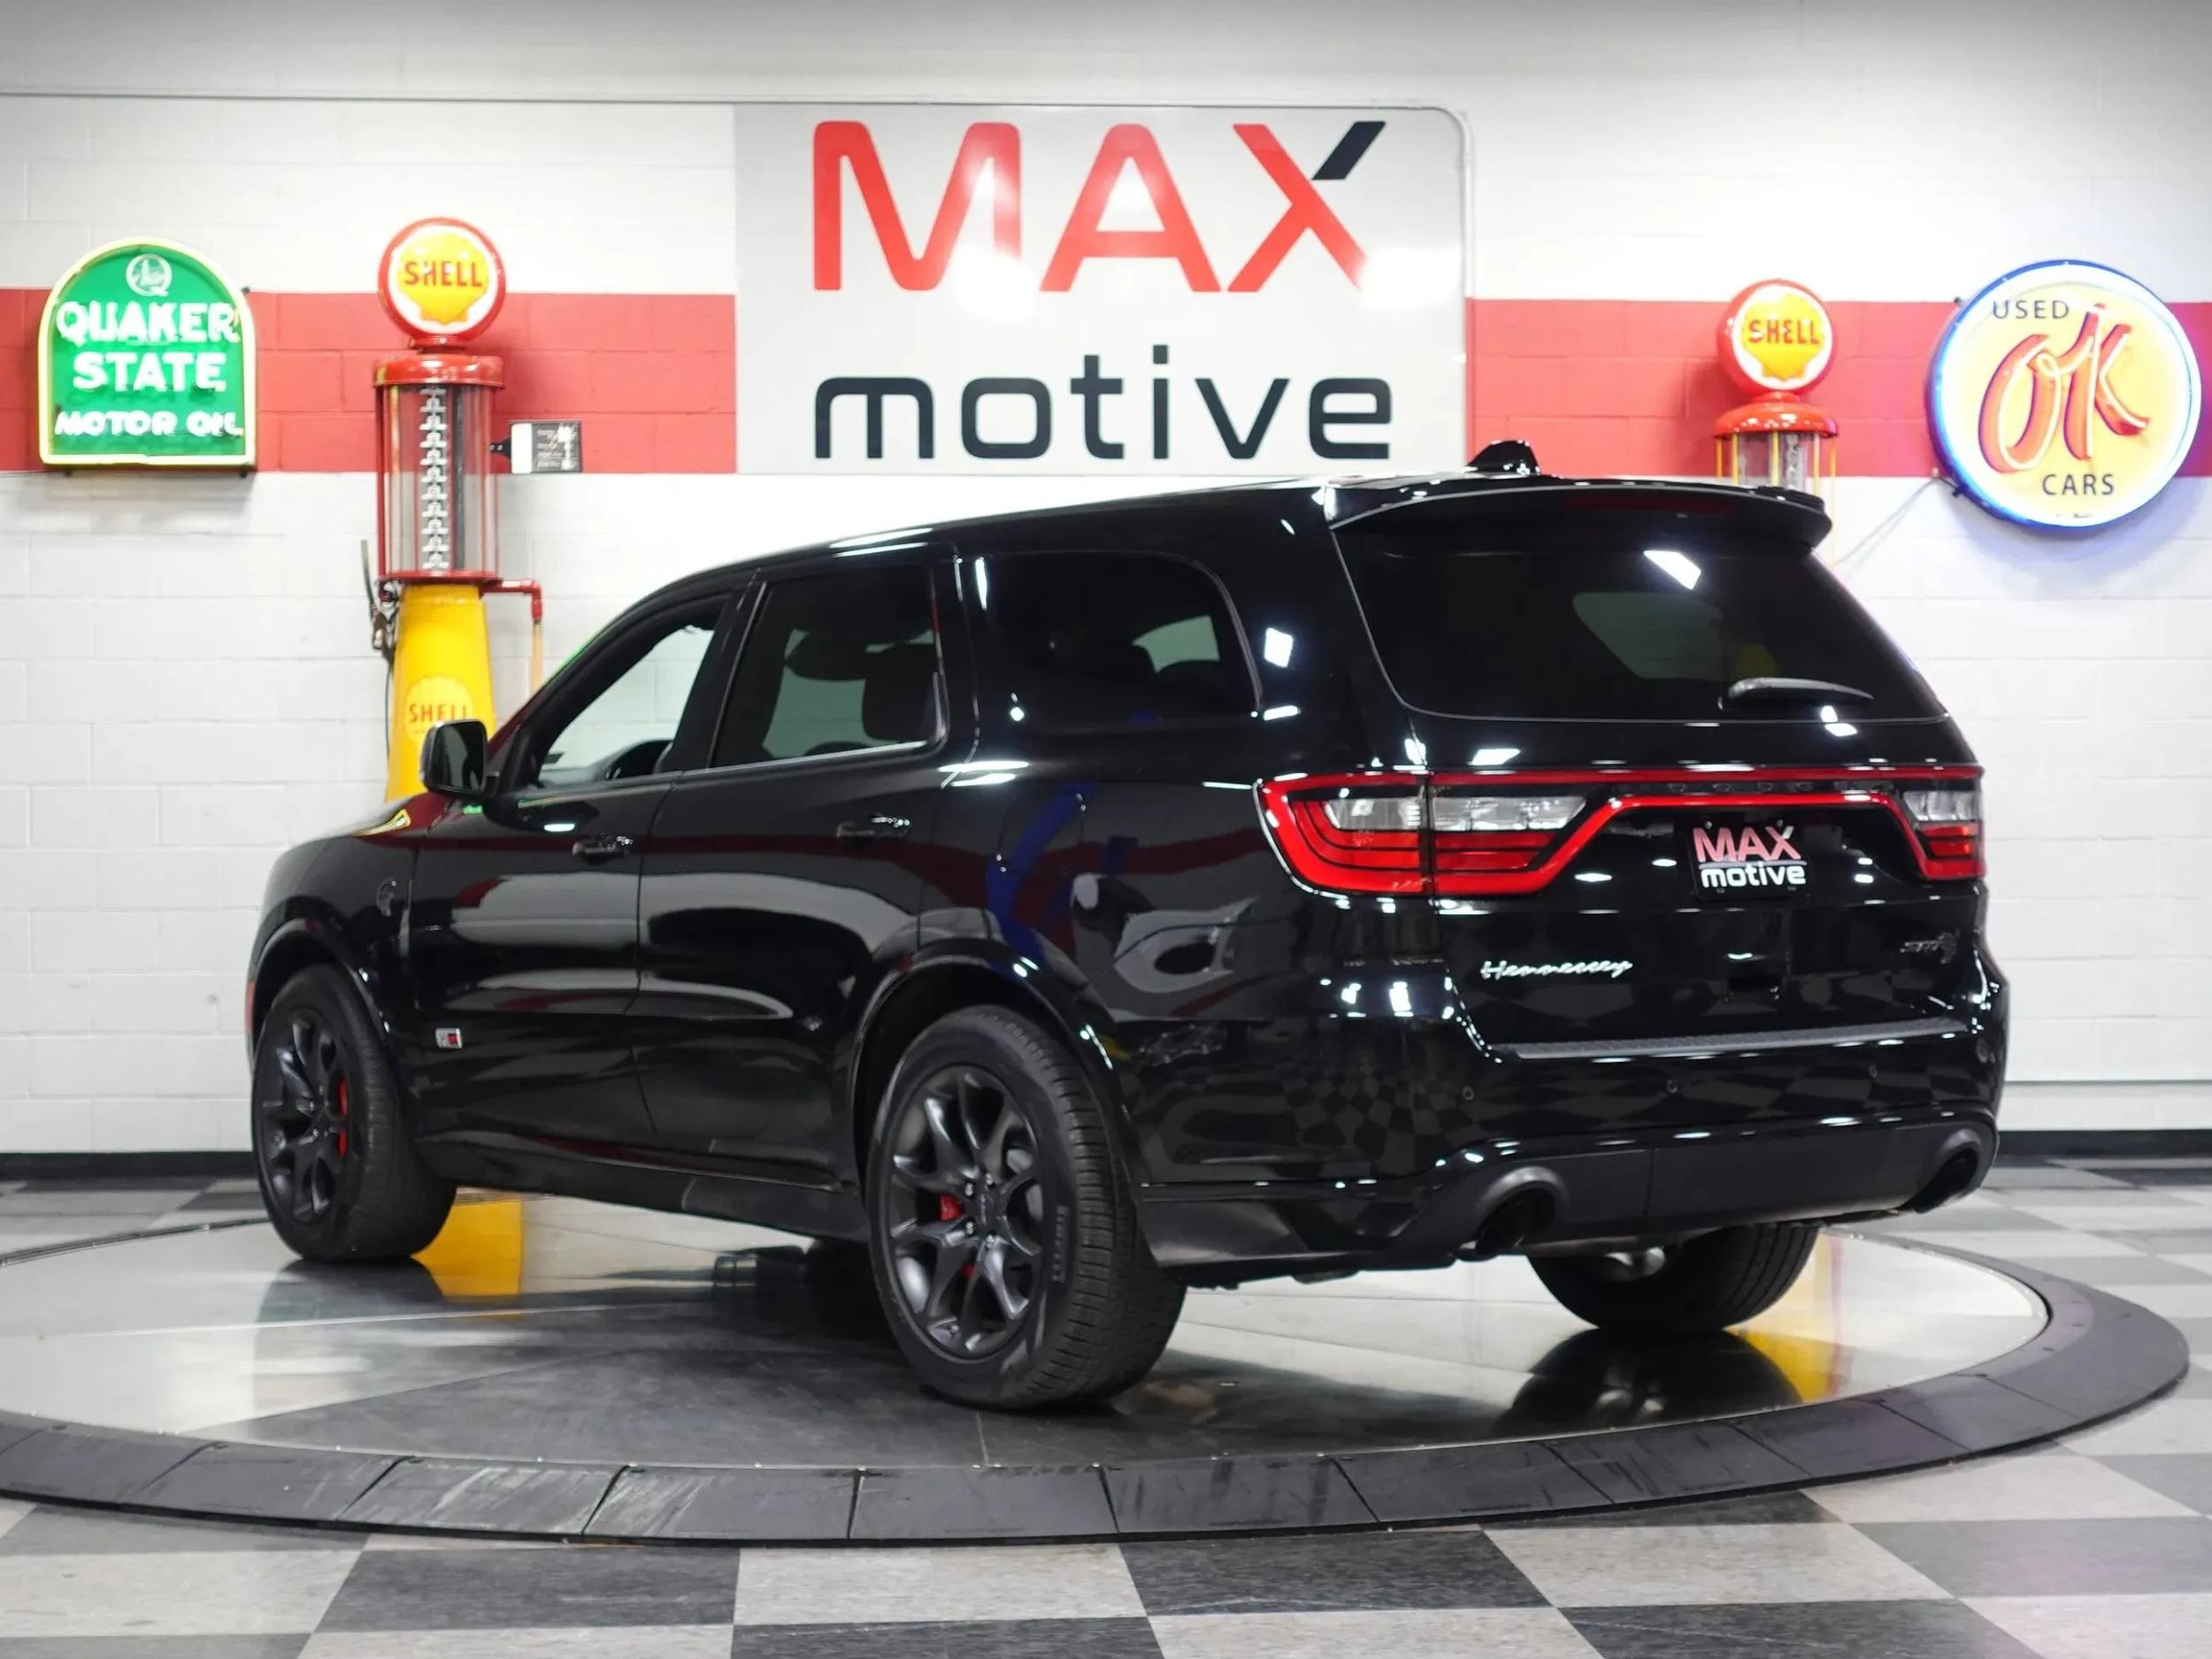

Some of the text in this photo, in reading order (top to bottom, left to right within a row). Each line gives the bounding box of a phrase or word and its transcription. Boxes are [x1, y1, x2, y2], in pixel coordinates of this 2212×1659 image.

[813, 120, 1386, 293] MAX
[403, 260, 482, 287] SHELL
[56, 300, 241, 347] QUAKER
[1993, 300, 2070, 319] USED
[1748, 319, 1819, 344] SHELL
[73, 351, 227, 392] STATE
[814, 345, 1392, 459] motive
[1978, 303, 2150, 473] OK
[55, 411, 243, 437] MOTOR OIL
[2042, 474, 2114, 495] CARS
[1693, 826, 1801, 862] MAX
[1701, 861, 1806, 887] motive
